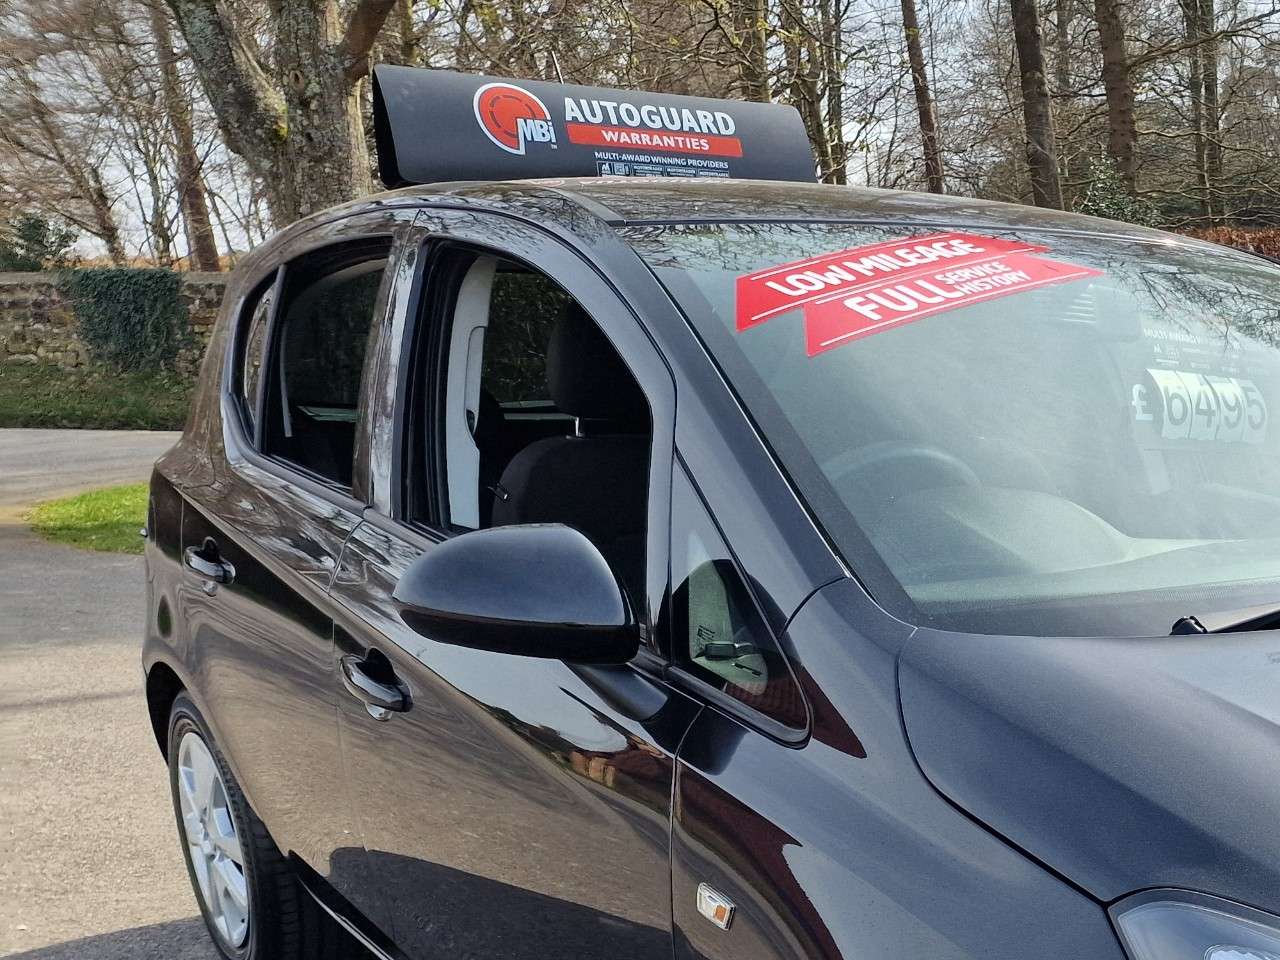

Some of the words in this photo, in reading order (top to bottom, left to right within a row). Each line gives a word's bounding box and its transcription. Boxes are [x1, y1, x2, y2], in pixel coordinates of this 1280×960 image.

[564, 97, 736, 136] AUTOGUARD
[601, 130, 710, 151] WARRANTIES
[594, 151, 651, 163] MULTI-AWARD
[651, 156, 687, 166] WINNING
[687, 158, 729, 169] PROVIDERS
[765, 264, 858, 297] LOW
[852, 238, 985, 278] MILEAGE
[938, 260, 1012, 285] SERVICE
[843, 275, 956, 321] FULL
[955, 270, 1031, 298] HISTORY
